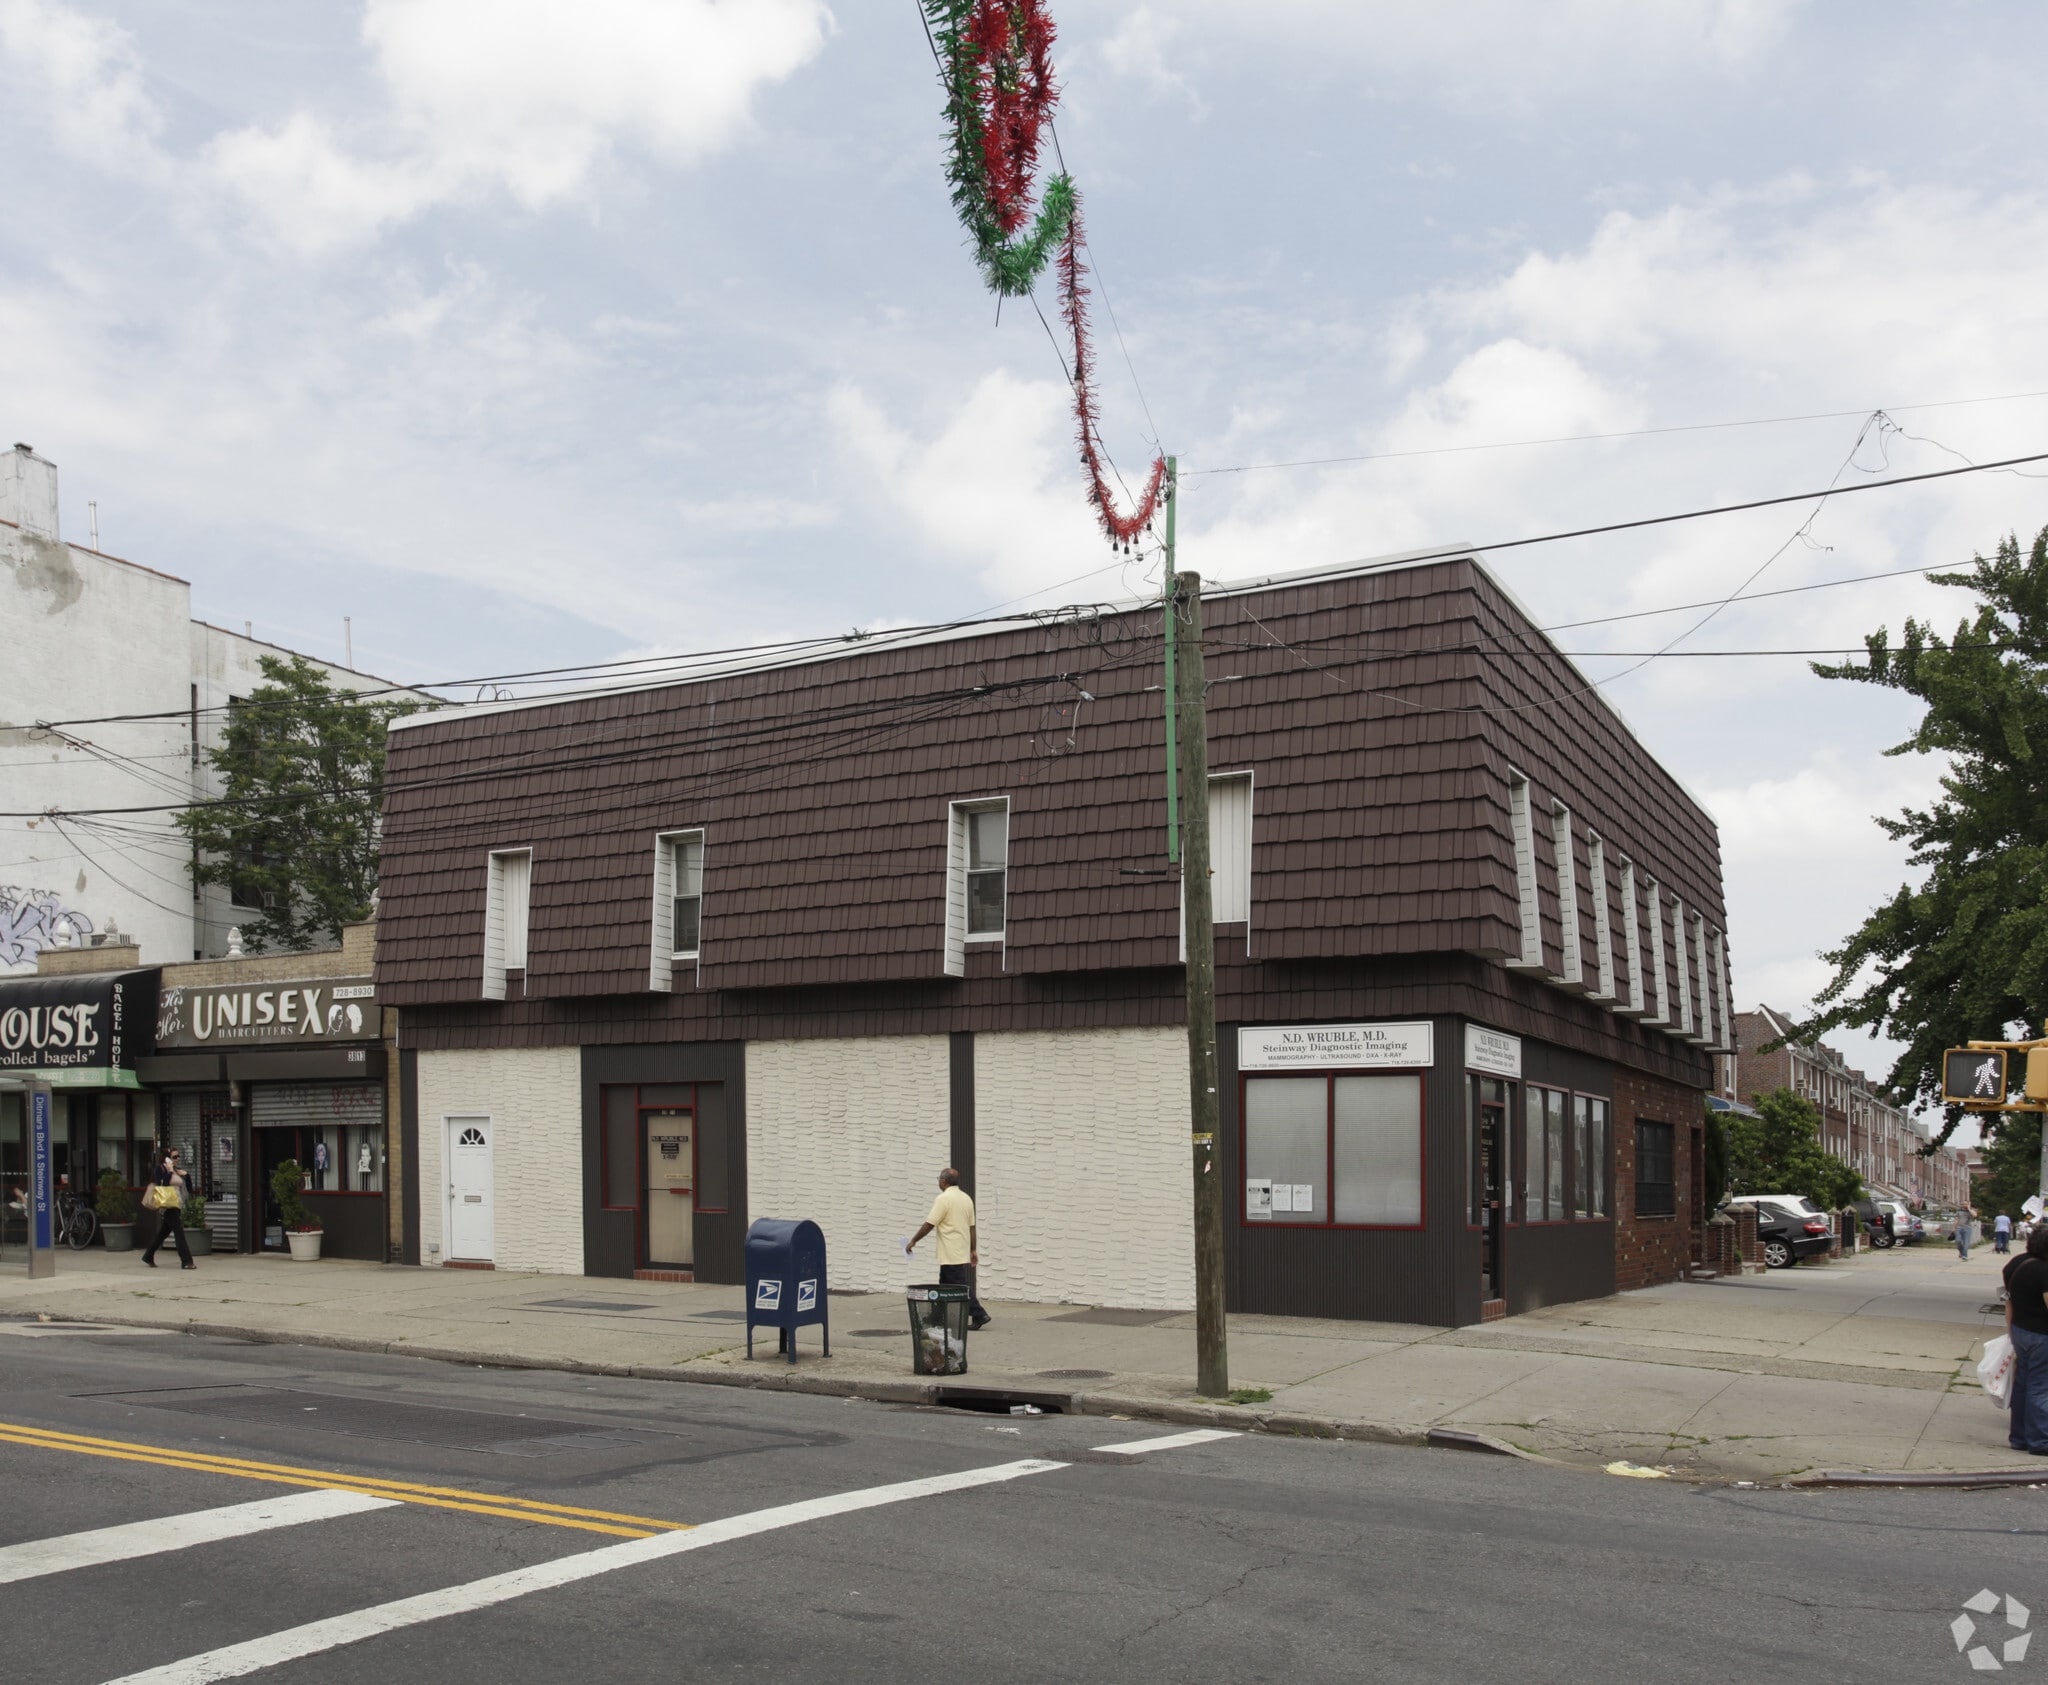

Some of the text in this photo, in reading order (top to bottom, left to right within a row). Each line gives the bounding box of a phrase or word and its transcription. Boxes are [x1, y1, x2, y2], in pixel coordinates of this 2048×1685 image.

[335, 986, 373, 998] 728-8930
[193, 988, 324, 1040] UNISEX
[0, 1002, 100, 1050] OUSE
[112, 983, 123, 1083] BAGEL HOUSE
[218, 1025, 294, 1039] HAIRCUTTERS
[1282, 1030, 1387, 1043] N.D. WRUBLE, M.D.
[1262, 1041, 1408, 1054] Steinway Diagnostic Imaging
[36, 1097, 44, 1130] Ditmars
[36, 1132, 45, 1151] Blvd
[36, 1162, 46, 1200] Steinway
[38, 1202, 46, 1212] St
